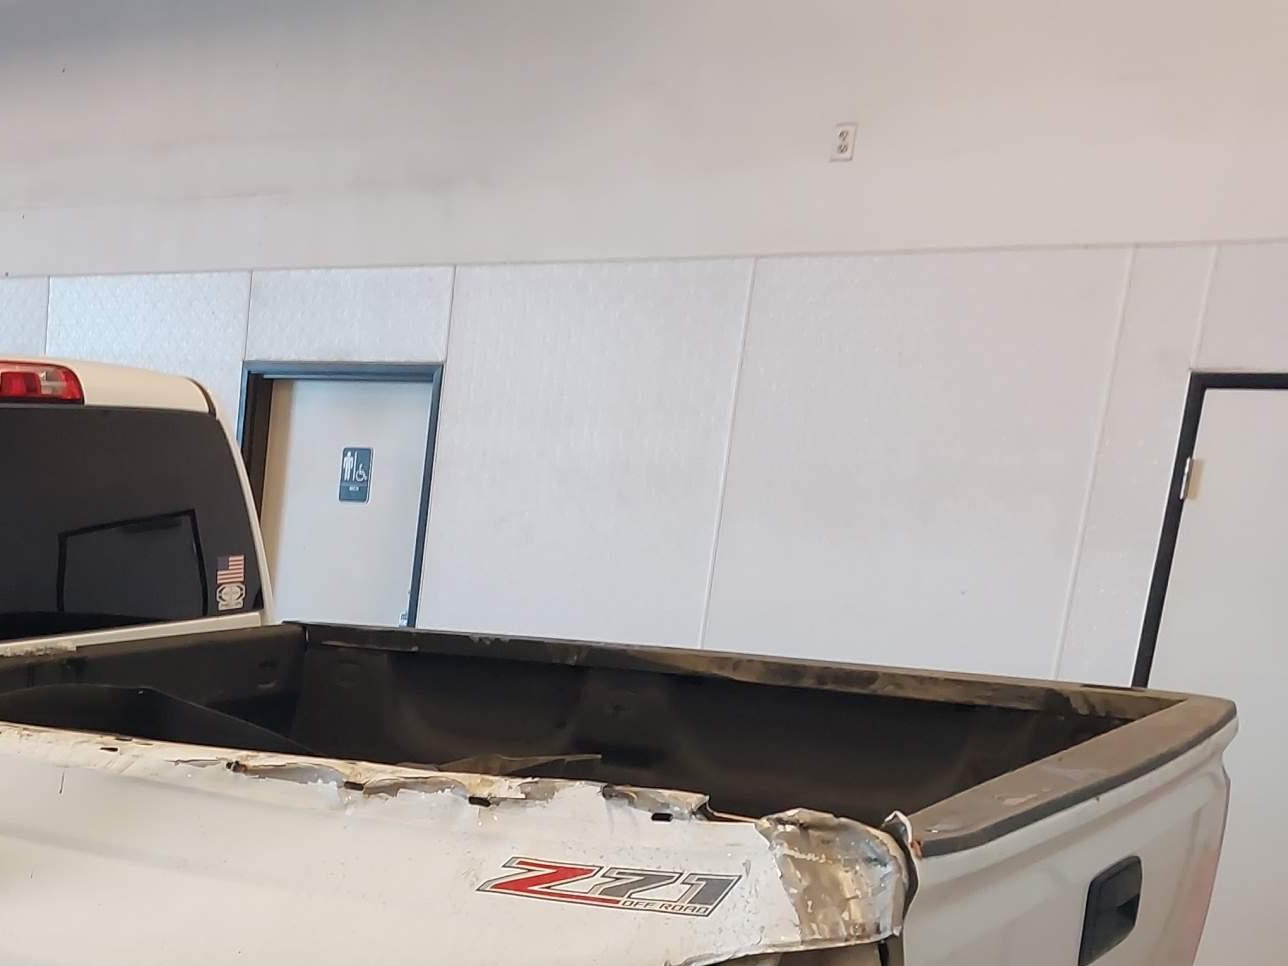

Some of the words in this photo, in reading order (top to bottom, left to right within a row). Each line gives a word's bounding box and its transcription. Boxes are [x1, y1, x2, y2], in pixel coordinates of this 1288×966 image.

[476, 857, 743, 917] Z71
[622, 900, 656, 909] OFF
[658, 903, 710, 915] ROAD
